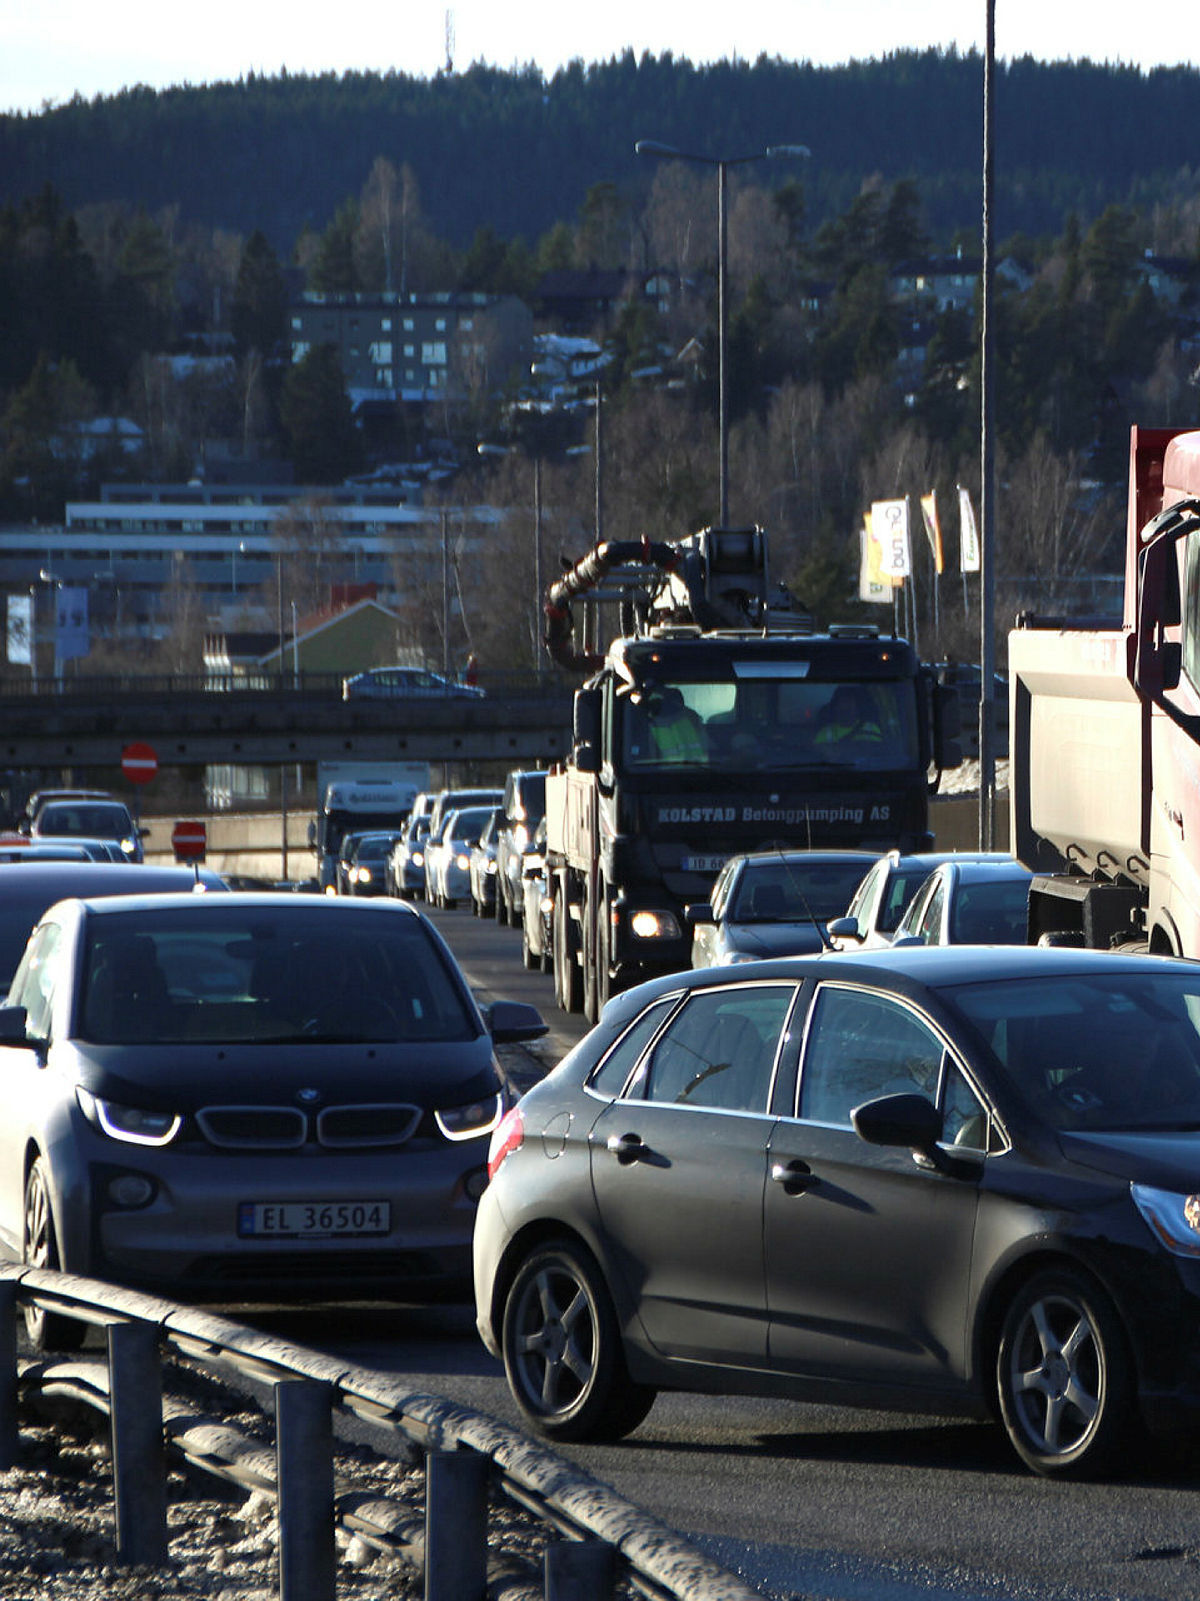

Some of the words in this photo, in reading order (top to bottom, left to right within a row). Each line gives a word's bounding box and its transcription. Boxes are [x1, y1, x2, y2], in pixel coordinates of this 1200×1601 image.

[658, 807, 736, 823] KOLSTAD
[742, 806, 863, 825] Betongpumping
[870, 805, 890, 821] AS
[263, 1207, 289, 1230] EL
[304, 1205, 382, 1229] 36504
